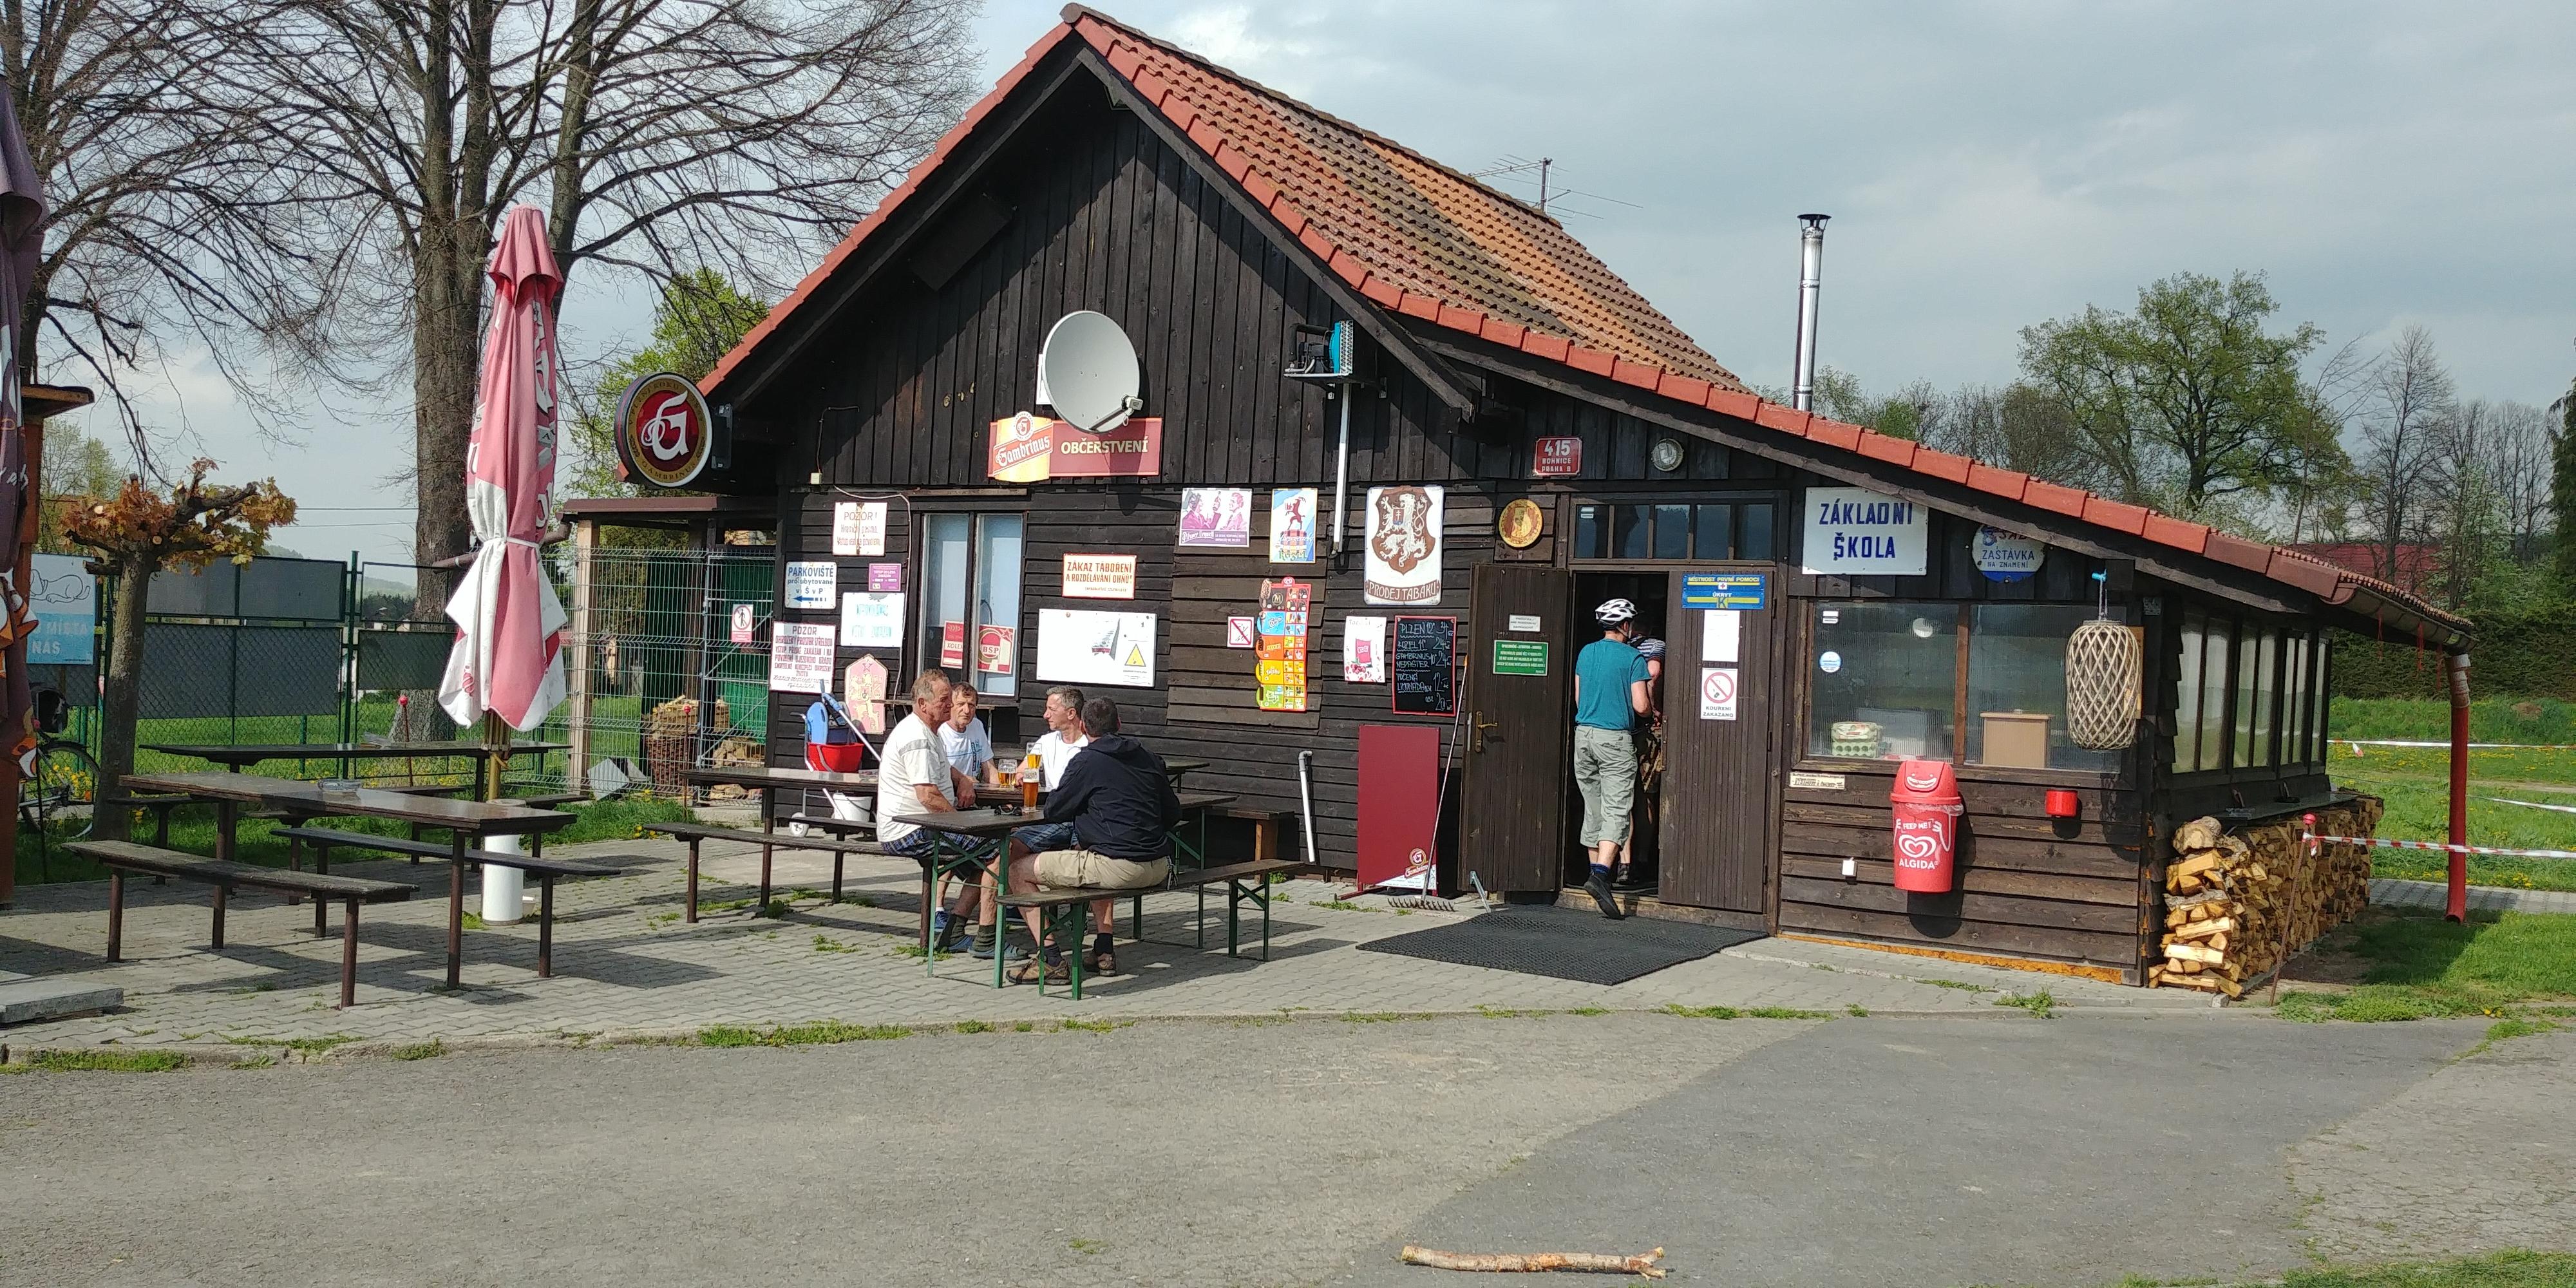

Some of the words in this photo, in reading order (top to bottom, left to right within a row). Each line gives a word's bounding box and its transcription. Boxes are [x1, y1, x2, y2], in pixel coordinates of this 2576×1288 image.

[996, 435, 1051, 467] Gambrinus
[1061, 435, 1148, 455] OBČERSTVENÍ
[1544, 440, 1571, 456] 415
[1833, 533, 1895, 559] ŠKOLA
[1982, 547, 2035, 560] ZASTÁVKA
[788, 565, 834, 577] PARKOVIŠTĚ
[1067, 560, 1093, 572] ZÁKAZ
[1369, 582, 1401, 600] PRODEJ
[1718, 597, 1727, 608] K
[792, 625, 817, 635] POZOR
